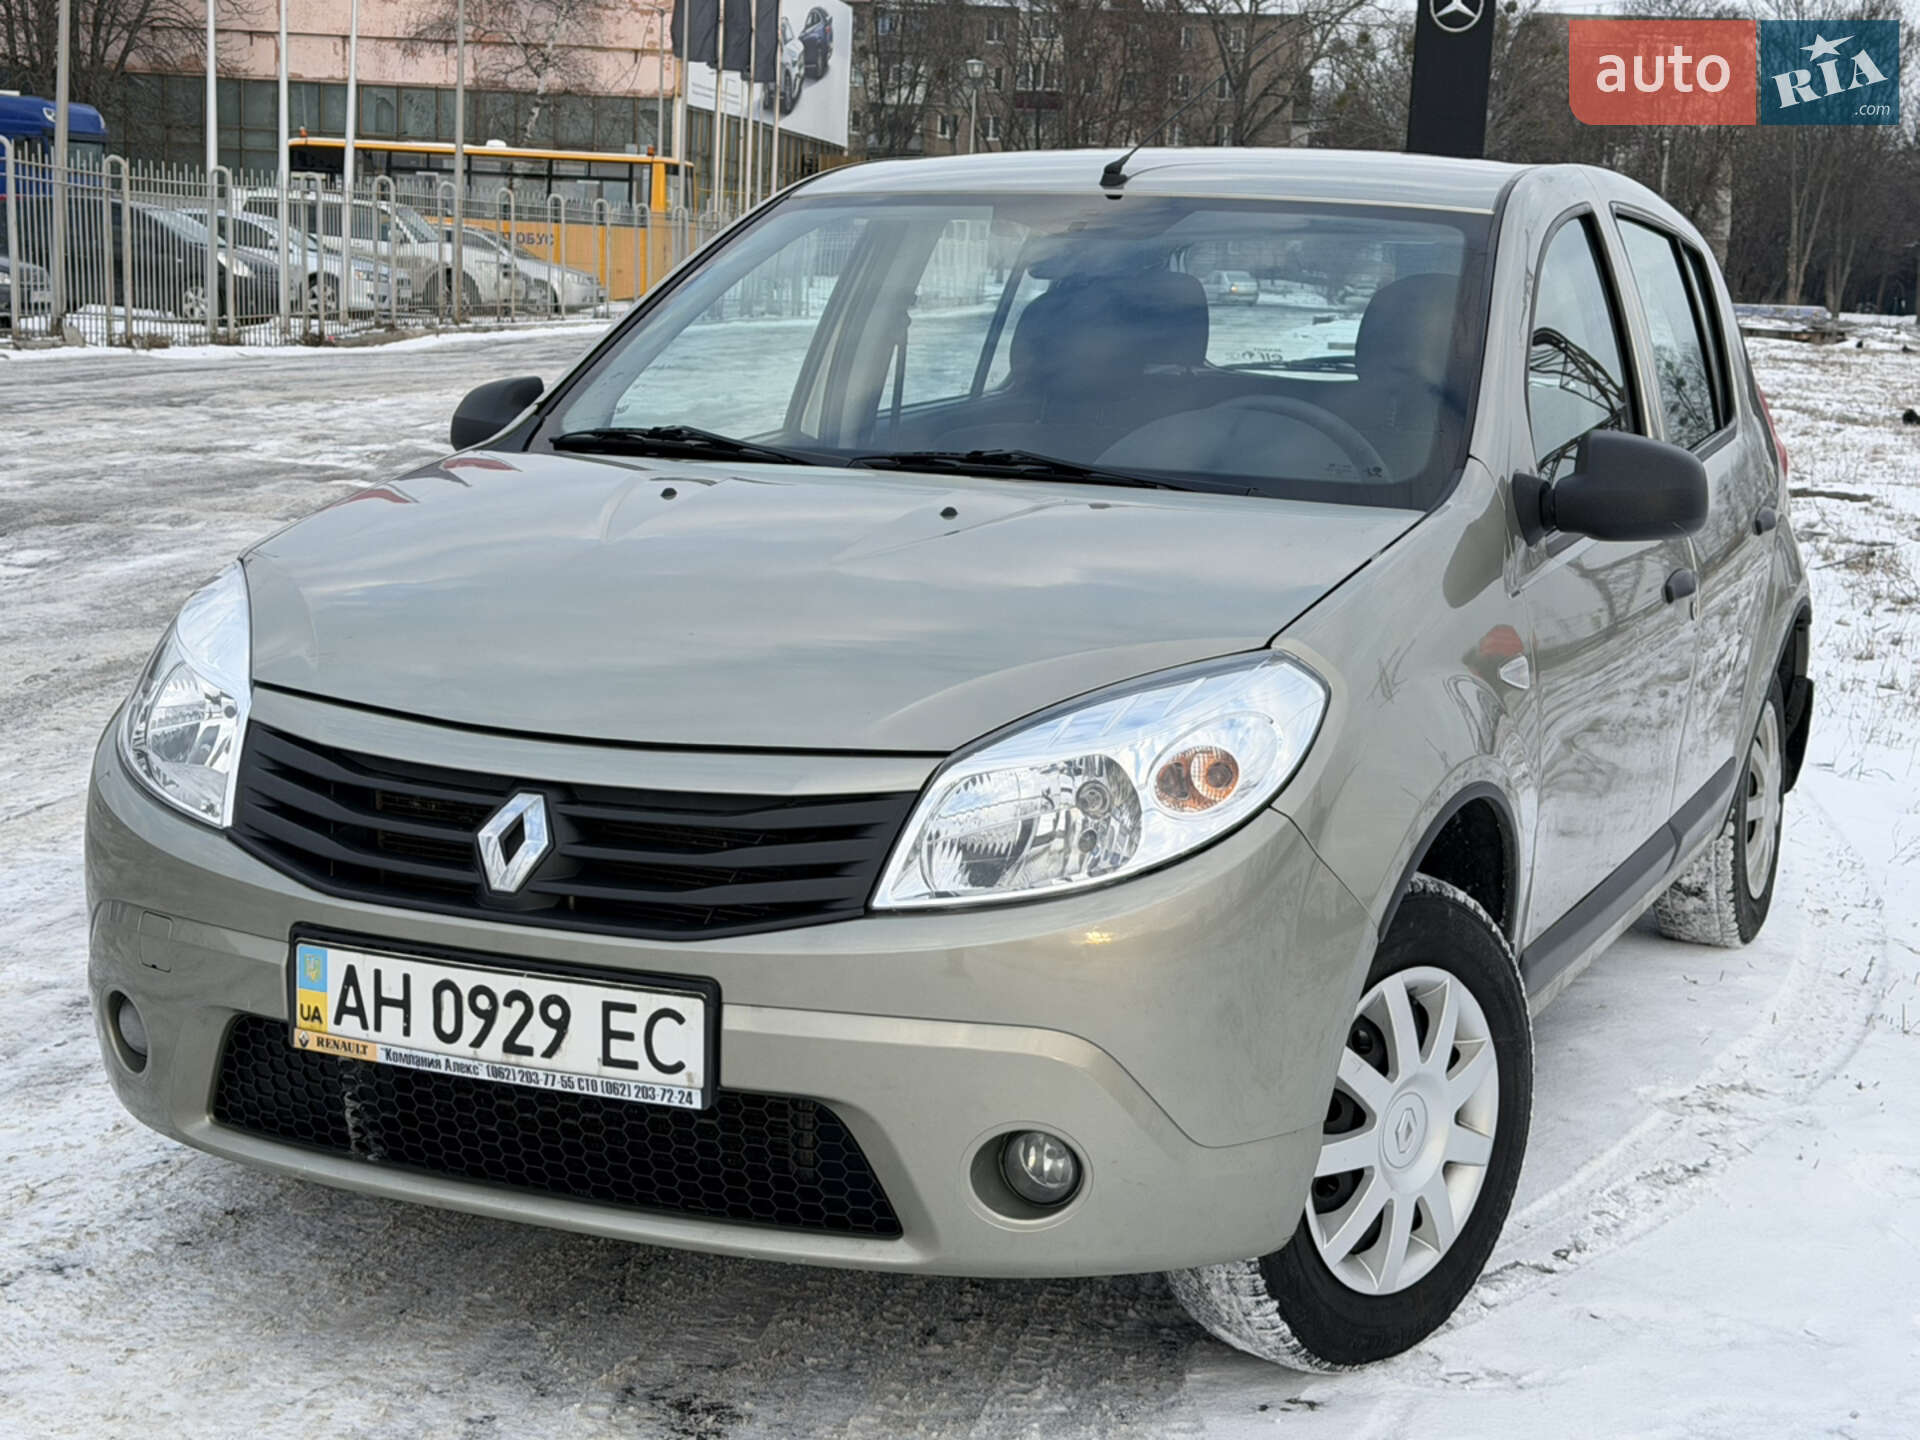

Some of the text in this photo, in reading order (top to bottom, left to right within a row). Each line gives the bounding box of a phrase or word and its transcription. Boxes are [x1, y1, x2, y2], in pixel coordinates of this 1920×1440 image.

[300, 1004, 323, 1025] UA
[333, 963, 686, 1075] AH 0929 EC
[316, 1036, 369, 1056] RENAULT
[517, 1068, 575, 1090] 203-77-55
[633, 1085, 694, 1105] 203-72-24
